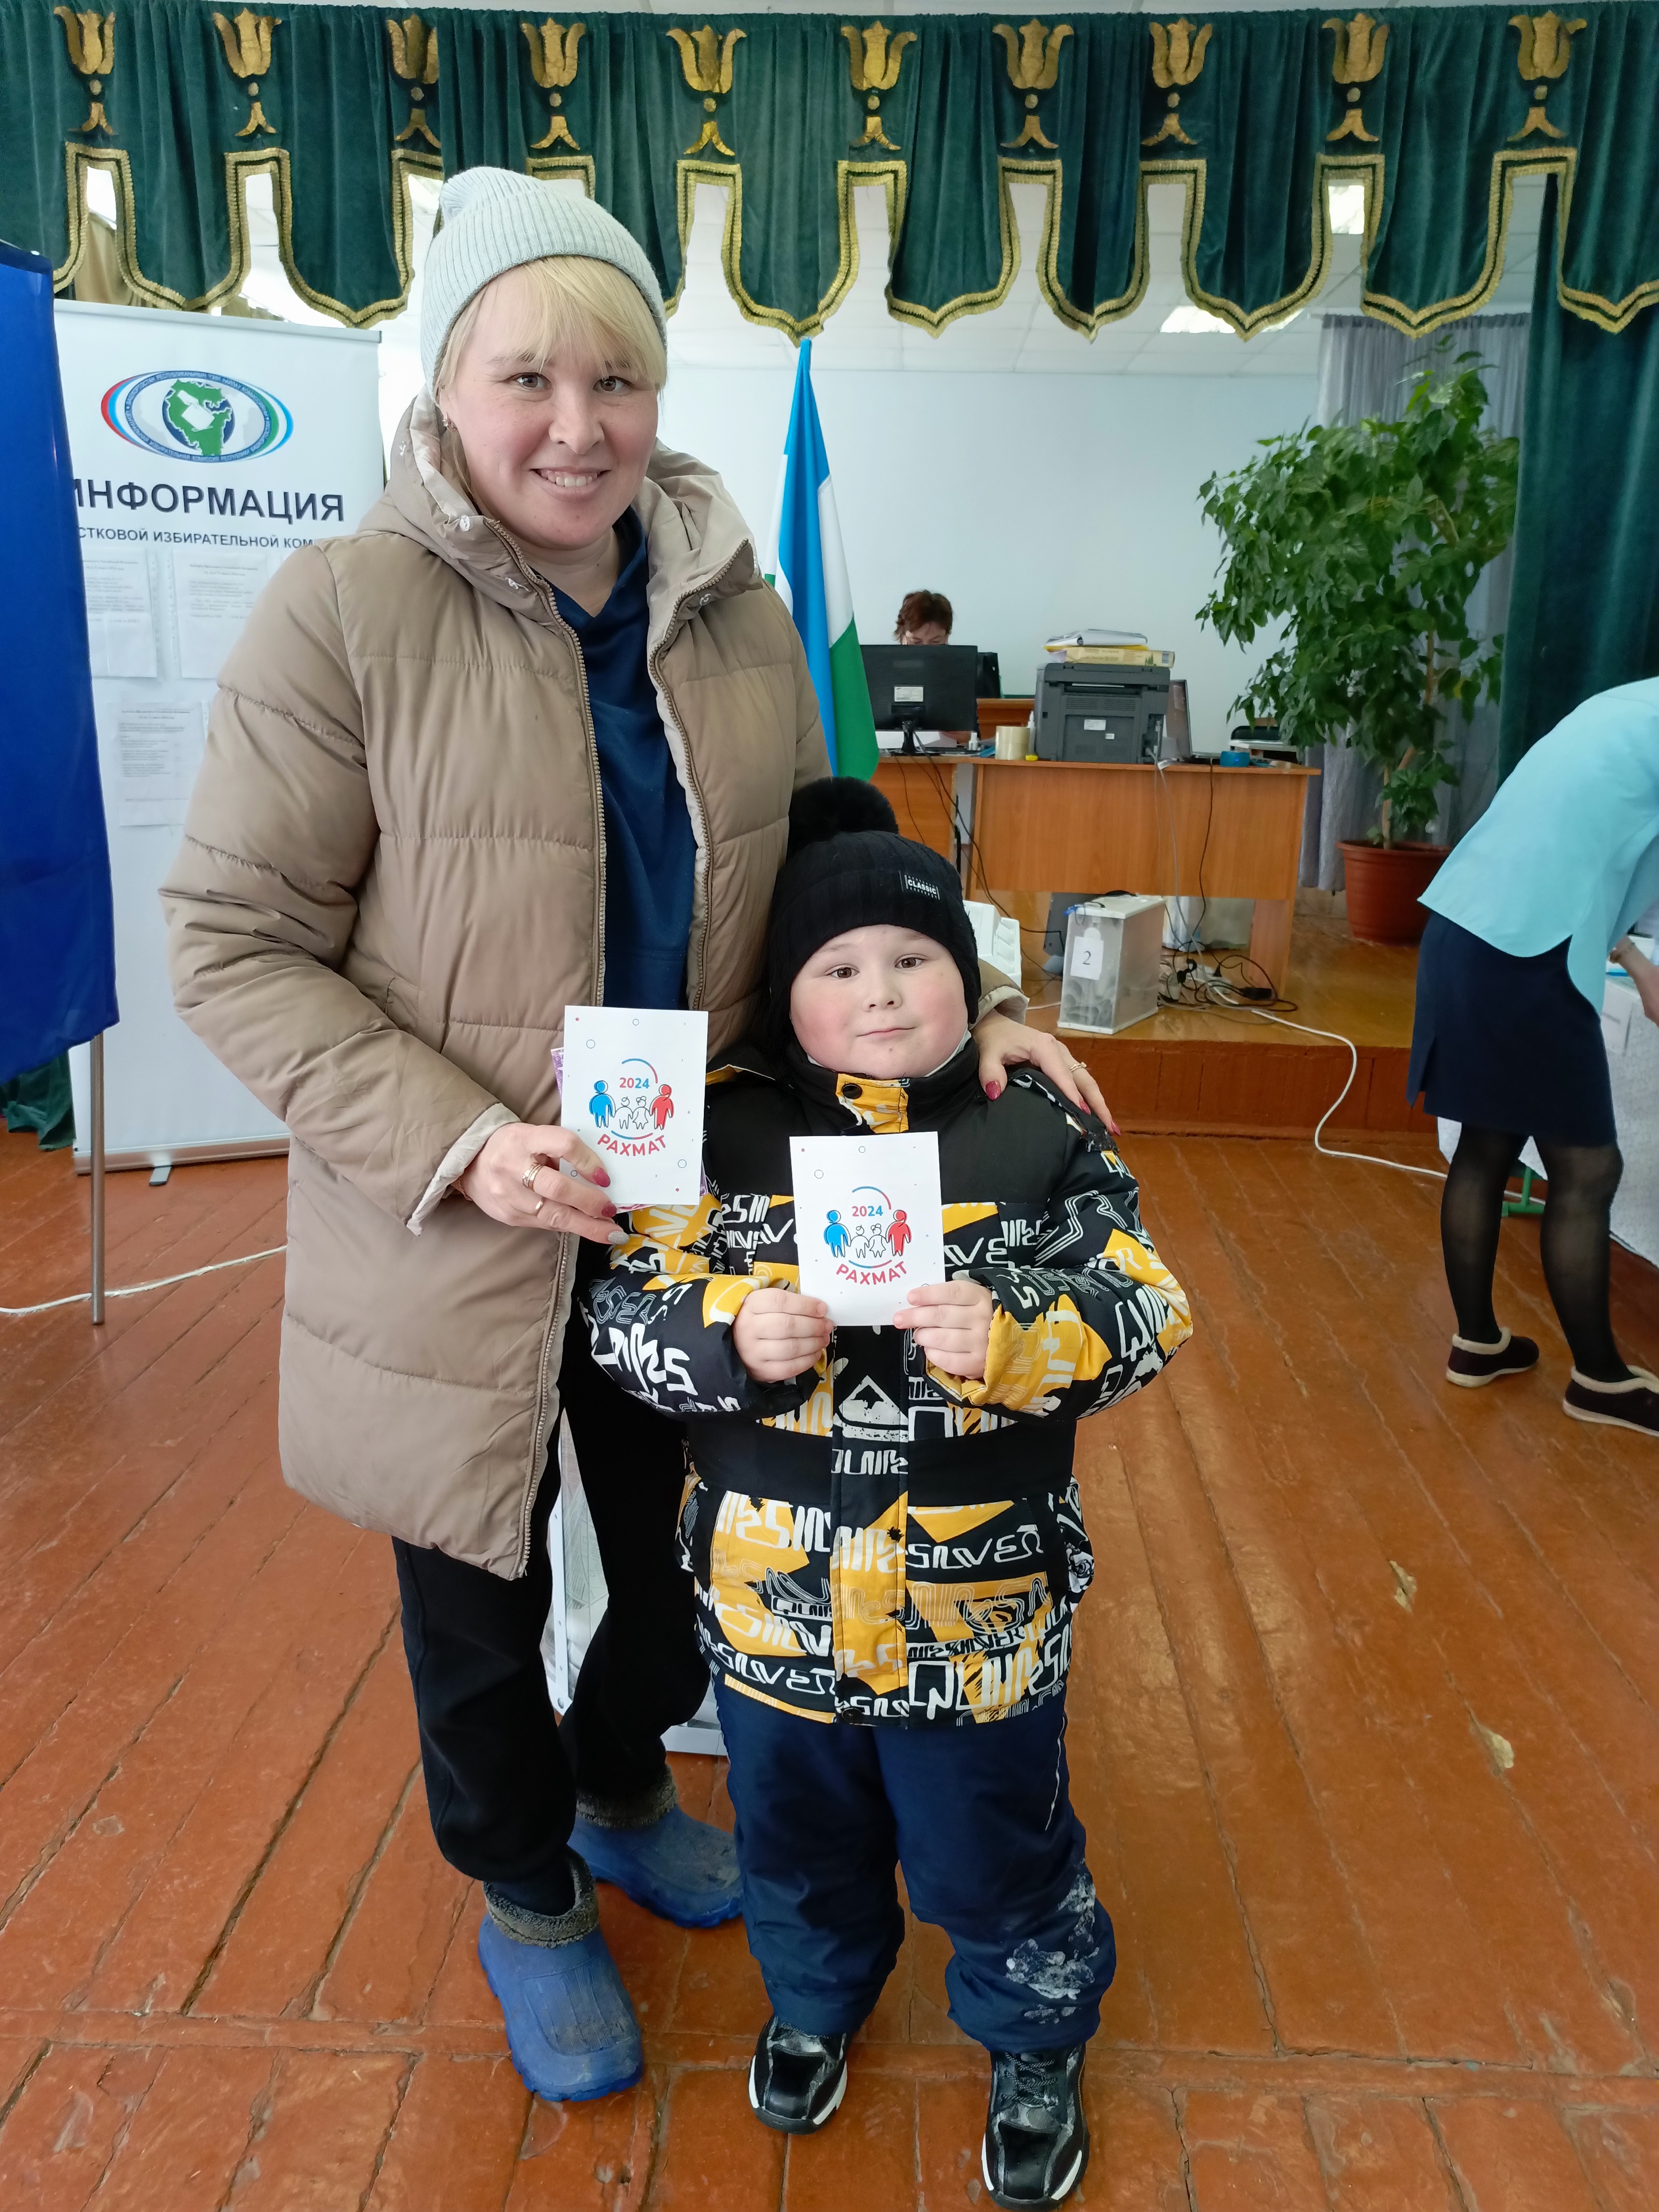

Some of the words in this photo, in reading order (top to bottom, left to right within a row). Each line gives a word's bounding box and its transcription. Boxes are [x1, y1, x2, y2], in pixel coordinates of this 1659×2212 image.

[153, 531, 279, 548] ИЗБИРАТЕЛЬНОЙ
[908, 879, 937, 895] CLASSIC
[1082, 950, 1091, 965] 2
[619, 1078, 650, 1089] 2024
[597, 1133, 666, 1156] РАХМАТ
[852, 1205, 883, 1217] 2024
[836, 1261, 908, 1285] РАХМАТ
